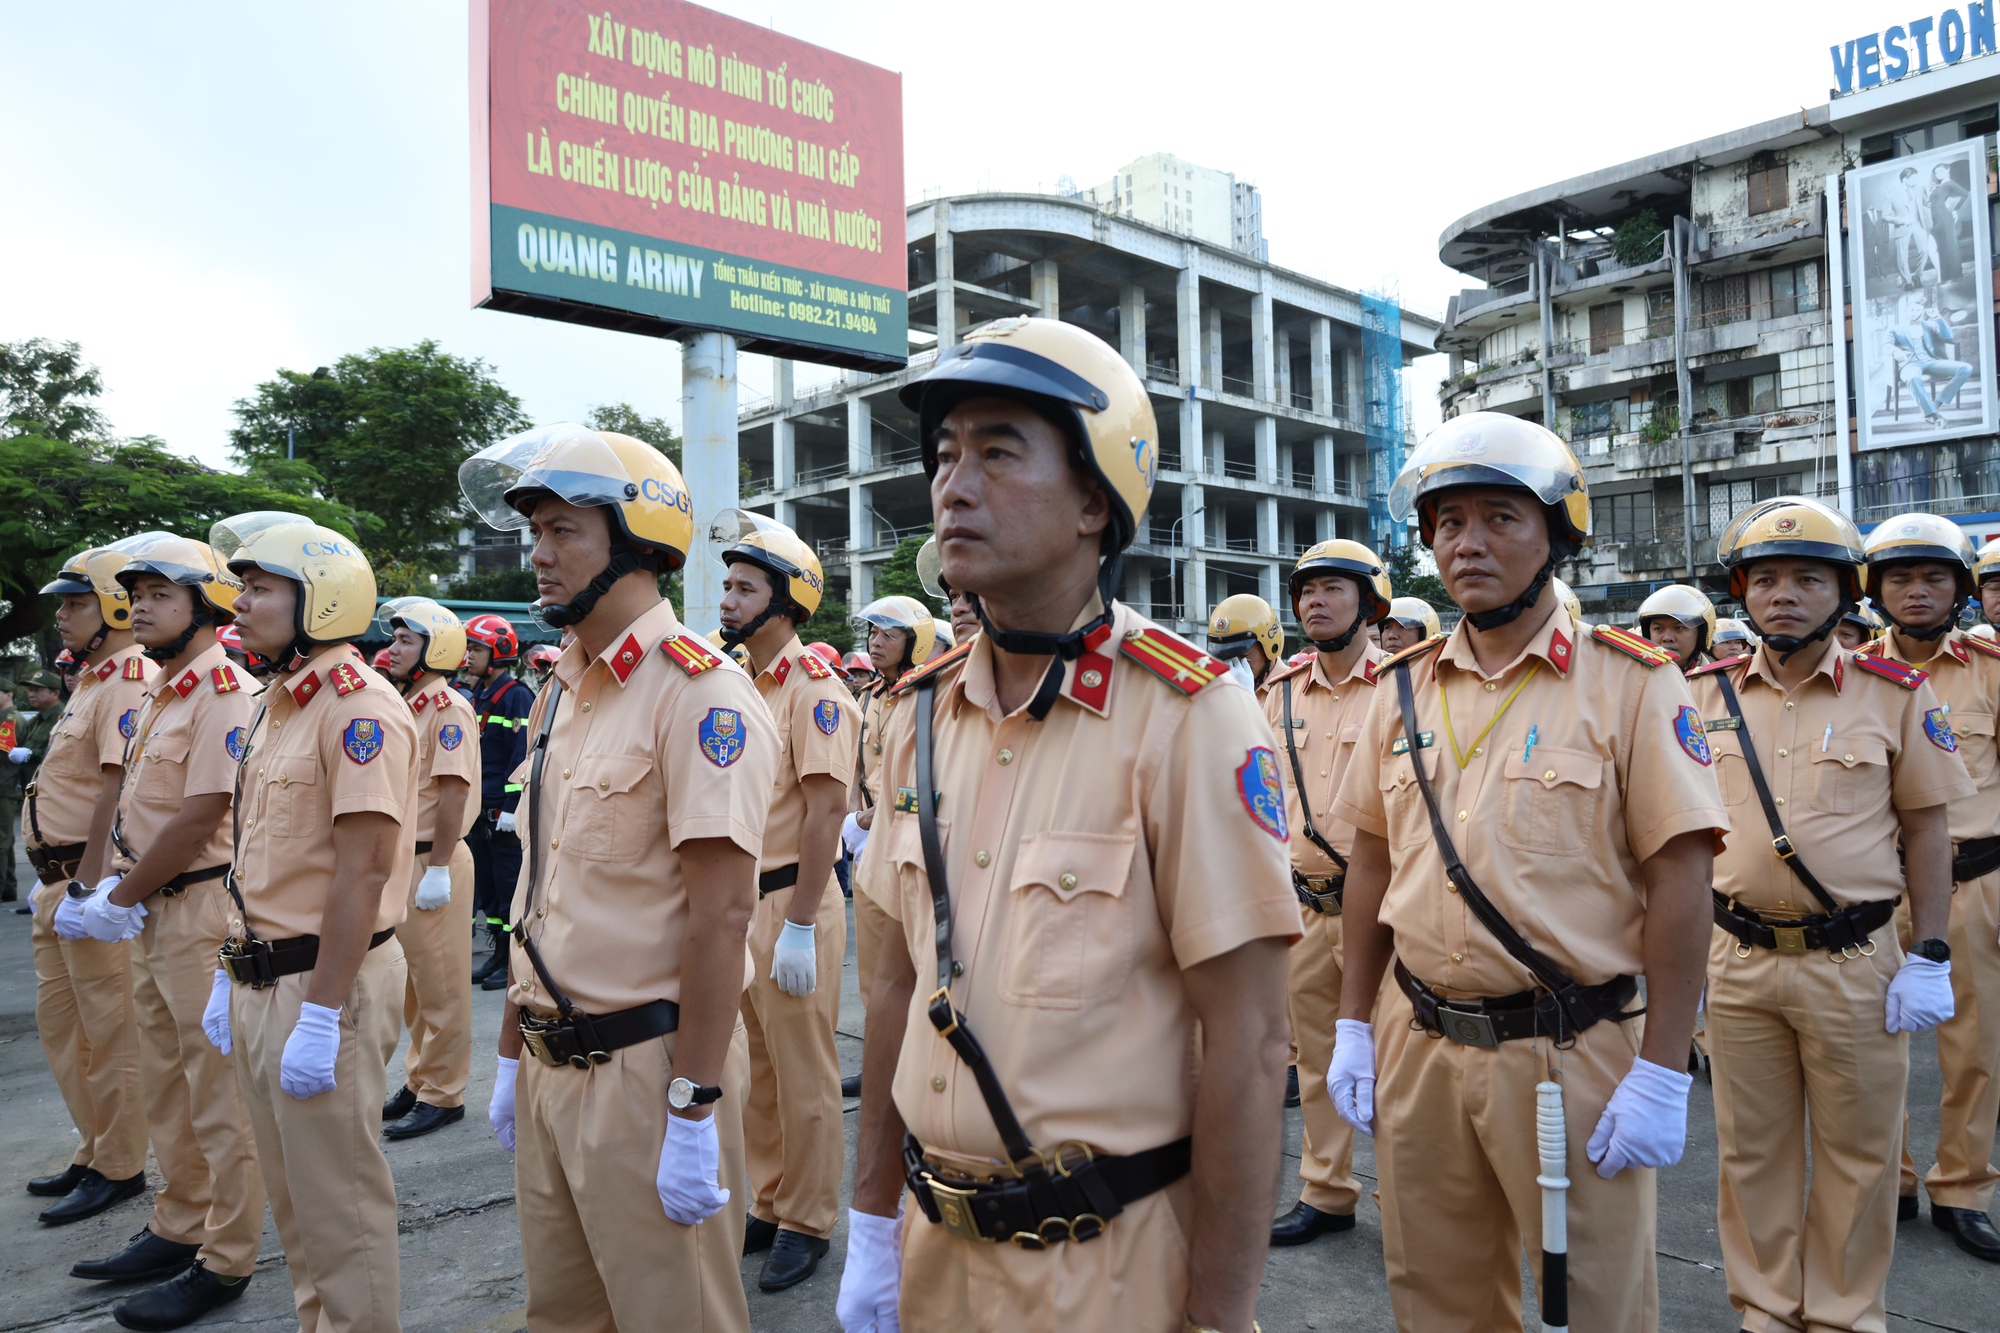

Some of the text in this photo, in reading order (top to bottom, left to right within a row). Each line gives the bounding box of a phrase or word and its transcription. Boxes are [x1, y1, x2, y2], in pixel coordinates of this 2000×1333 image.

[588, 11, 834, 123] XÂY DỰNG MÔ HÌNH TỔ CHỨC
[1830, 0, 1997, 95] VESTON
[556, 72, 860, 188] CHÍNH QUYỀN ĐỊA PHƯƠNG HAI CẤP
[527, 127, 882, 253] LÀ CHIẾN LƯỢC CỦA ĐẢNG VÀ NHÀ NƯỚC!
[518, 223, 704, 299] QUANG ARMY
[712, 258, 736, 284] TỔNG
[761, 270, 780, 292] KIẾN
[782, 276, 803, 297] TRÚC
[810, 281, 825, 301] XÂY
[827, 286, 848, 307] DỰNG
[850, 292, 856, 307] &
[858, 291, 871, 313] NỘI
[873, 293, 890, 314] THẤT
[730, 289, 877, 335] Hotline: 0982.21.9494
[706, 737, 740, 747] CS GT
